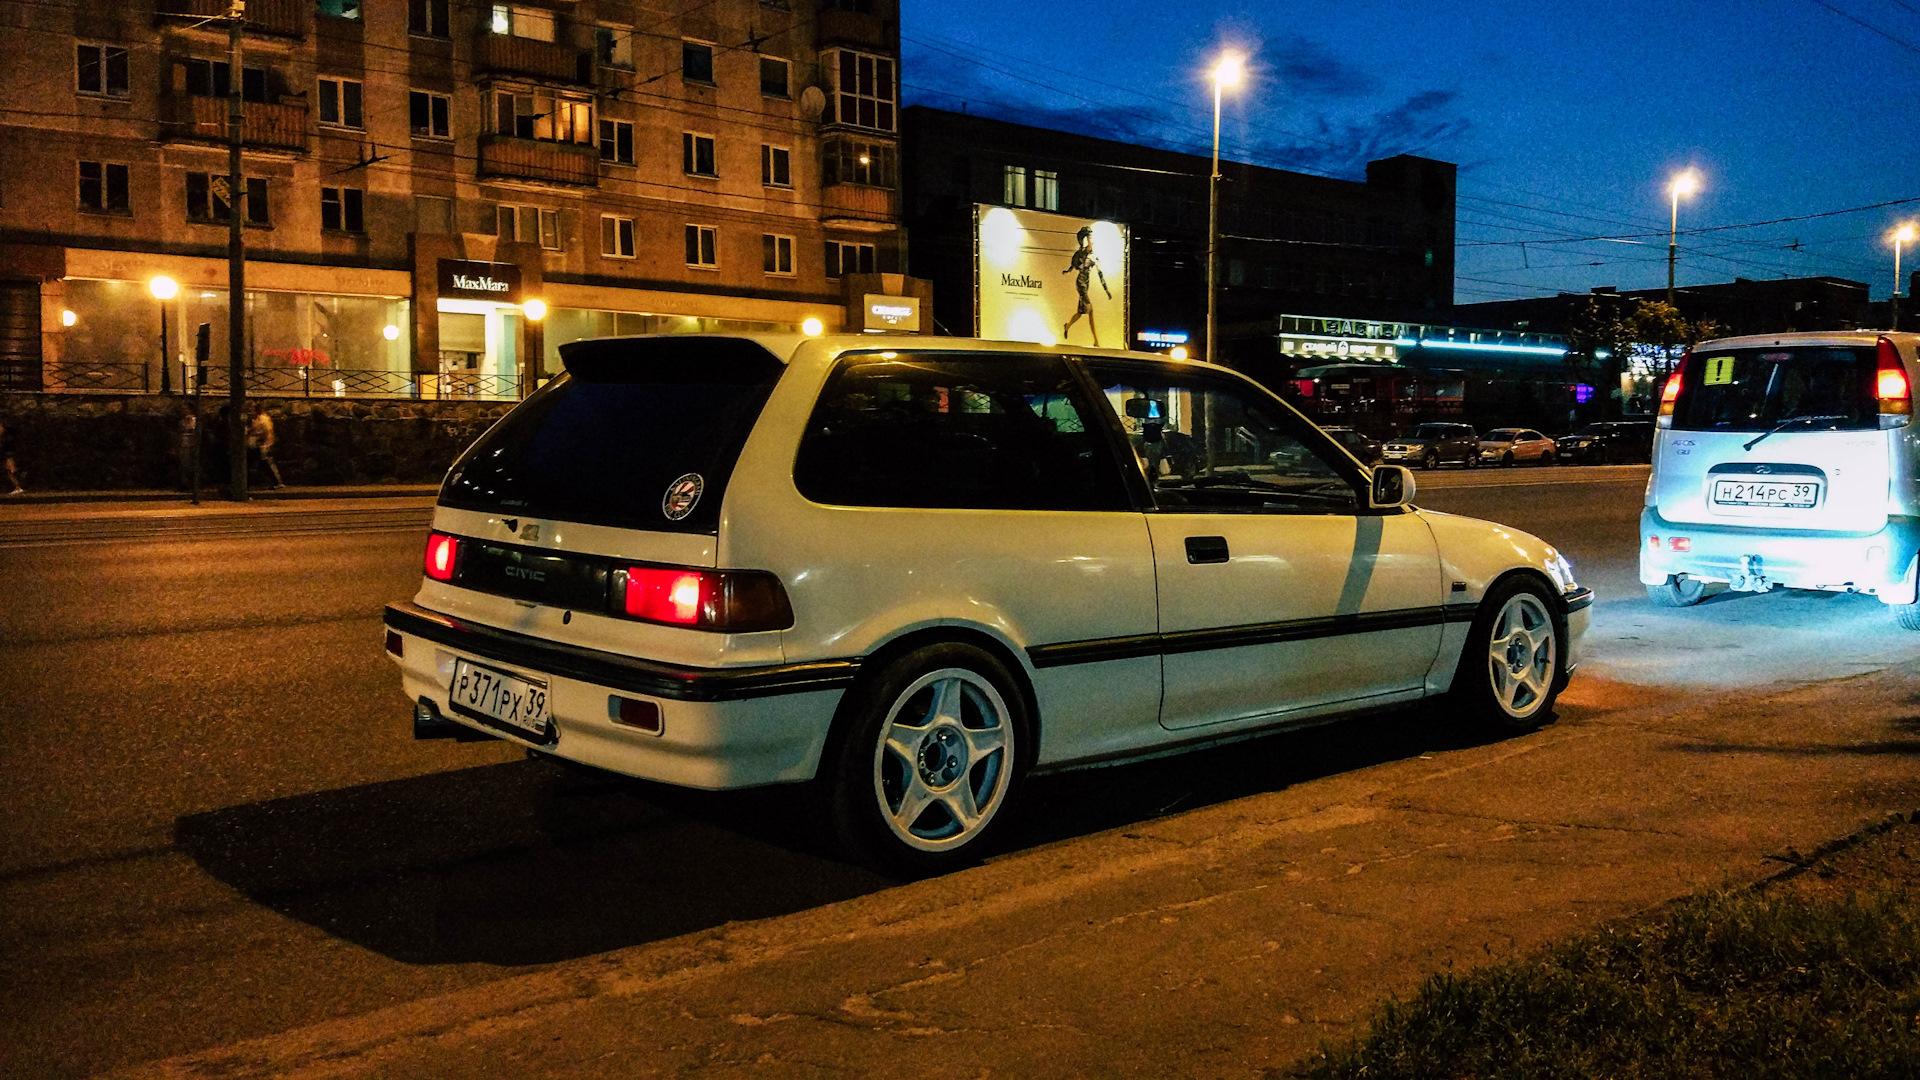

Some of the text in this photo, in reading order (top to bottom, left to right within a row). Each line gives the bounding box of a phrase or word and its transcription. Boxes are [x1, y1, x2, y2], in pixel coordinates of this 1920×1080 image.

[452, 274, 509, 292] MaxMara
[1001, 272, 1043, 289] MaxMara
[1793, 484, 1810, 498] 39
[505, 565, 547, 583] CIVIC
[525, 687, 546, 718] 39
